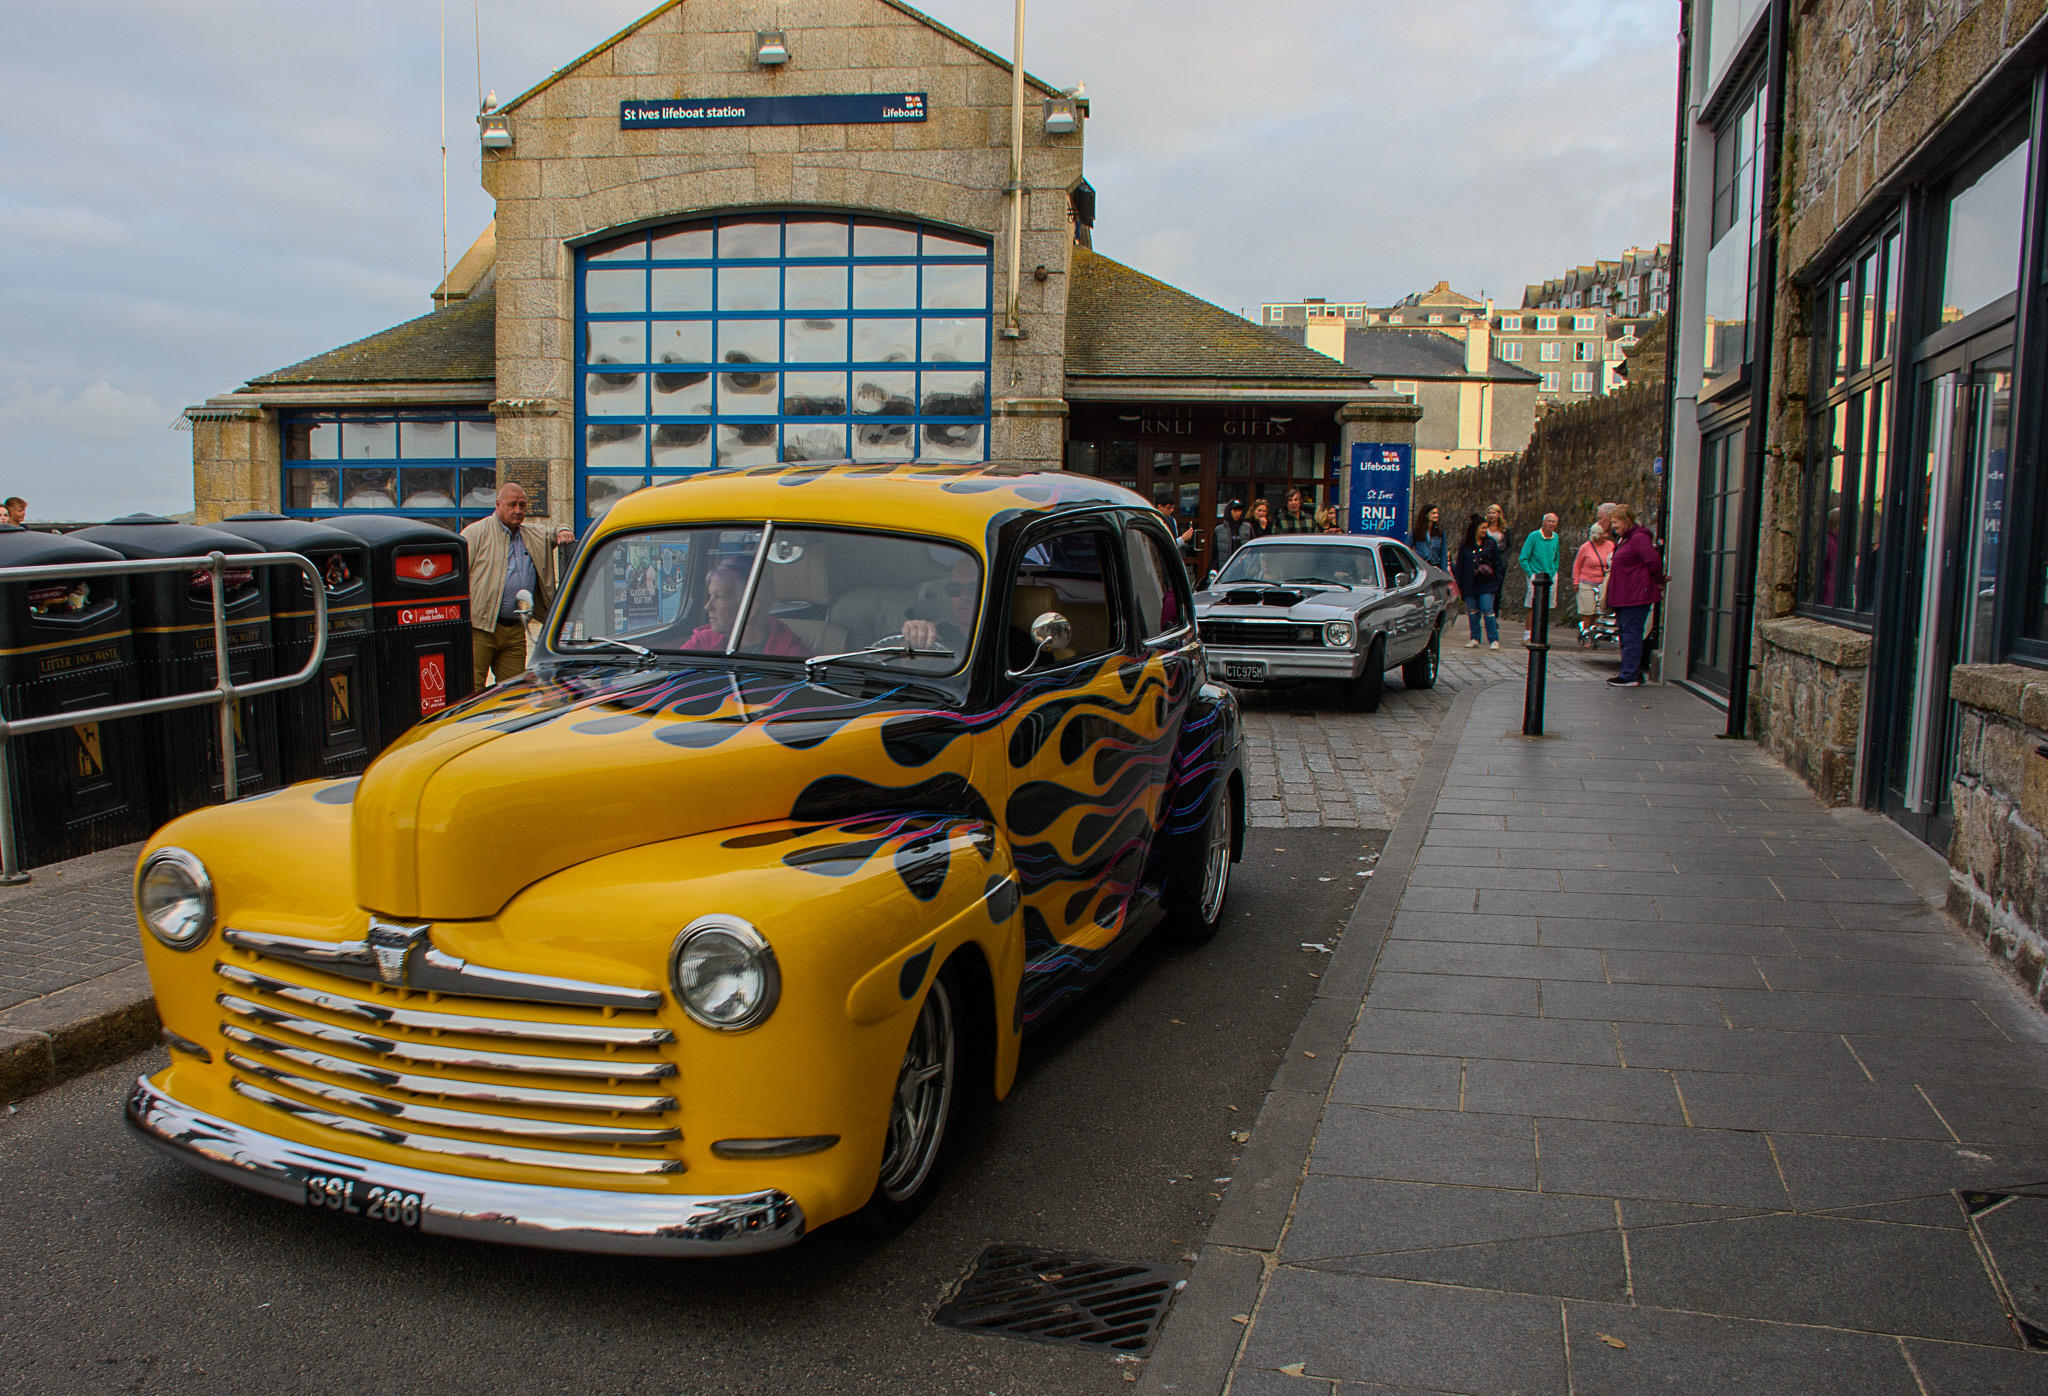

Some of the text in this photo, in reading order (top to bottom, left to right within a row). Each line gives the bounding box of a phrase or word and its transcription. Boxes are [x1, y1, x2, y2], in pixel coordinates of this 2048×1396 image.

[624, 105, 746, 120] St Ives lifeboat station
[883, 107, 924, 118] Lifeboats
[1141, 420, 1286, 436] RNLI GIFTS
[1360, 462, 1400, 471] Lifeboats
[1367, 489, 1394, 500] St Ives
[1361, 506, 1396, 519] RNLI
[1361, 519, 1395, 531] SHOP
[41, 656, 72, 673] LITTER
[94, 647, 119, 662] WASTE
[308, 1175, 421, 1227] SSL 266
